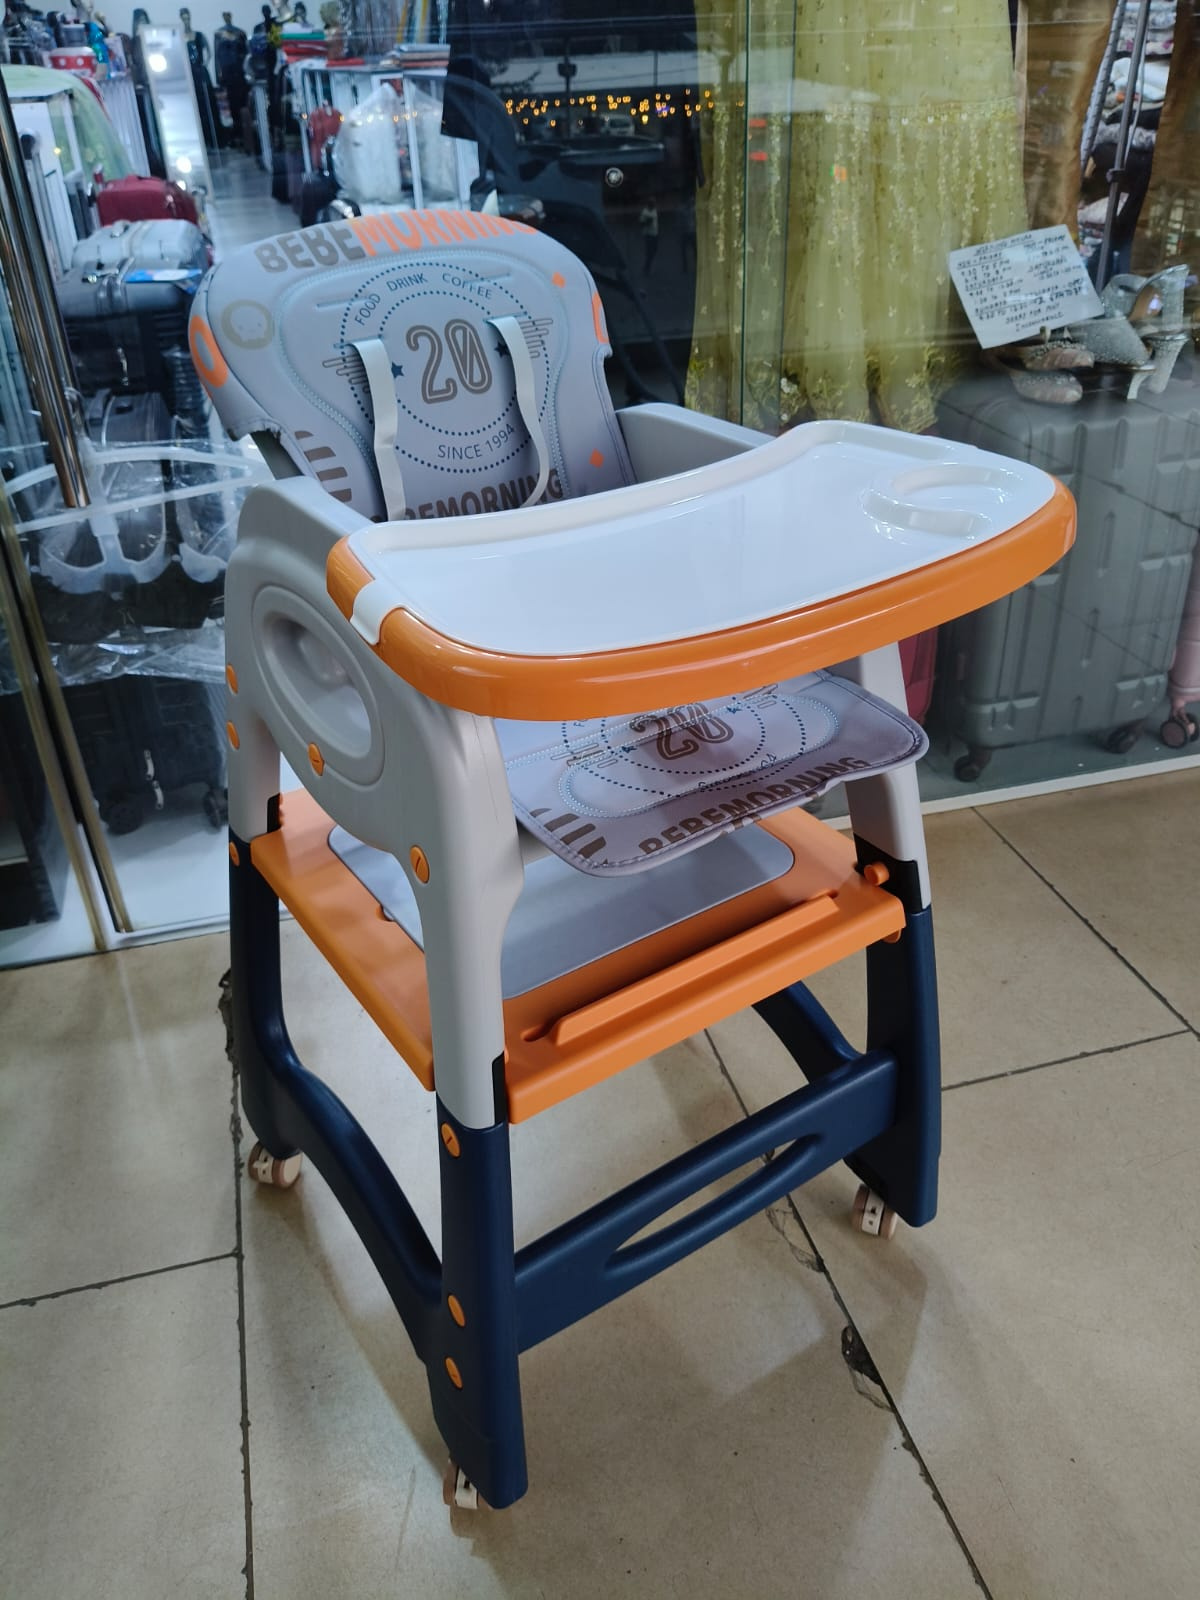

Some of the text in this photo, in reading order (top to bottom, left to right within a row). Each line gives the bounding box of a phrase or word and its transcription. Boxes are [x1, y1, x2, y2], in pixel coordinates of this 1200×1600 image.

[354, 272, 493, 326] FOOD DRINK COFFEE
[406, 319, 493, 404] 20
[437, 423, 515, 460] SINCE 1994
